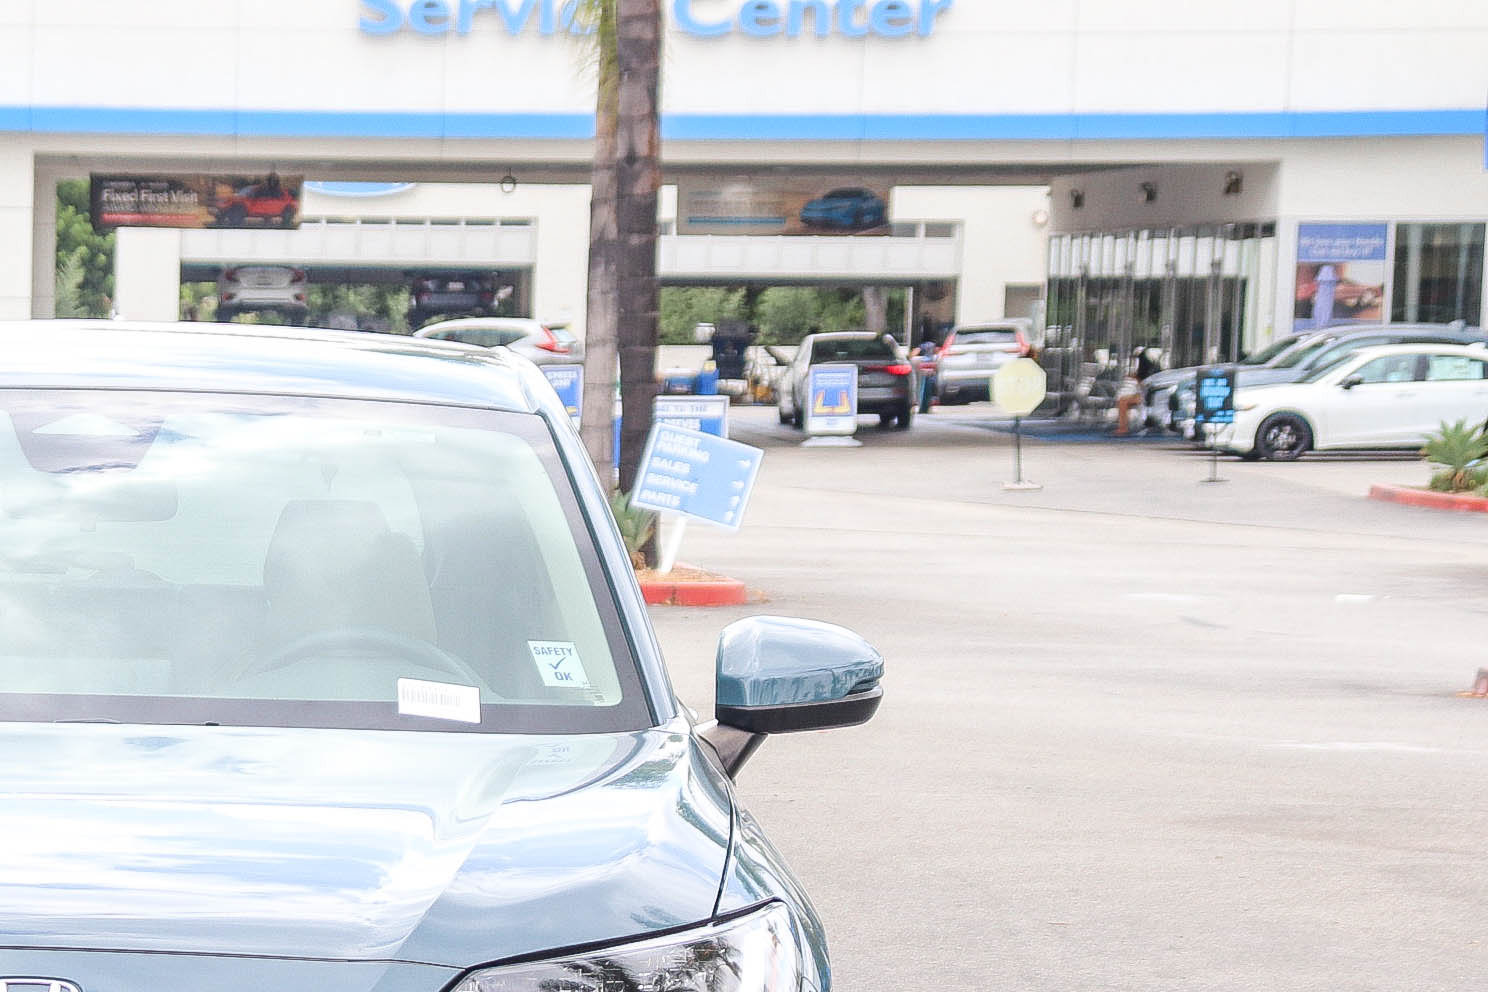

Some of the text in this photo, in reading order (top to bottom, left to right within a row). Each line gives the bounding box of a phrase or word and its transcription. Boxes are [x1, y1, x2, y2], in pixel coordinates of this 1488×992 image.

[674, 0, 954, 38] Center
[652, 456, 690, 474] SALES
[640, 489, 680, 507] PARTS
[533, 645, 573, 657] SAFETY
[555, 671, 572, 682] OK
